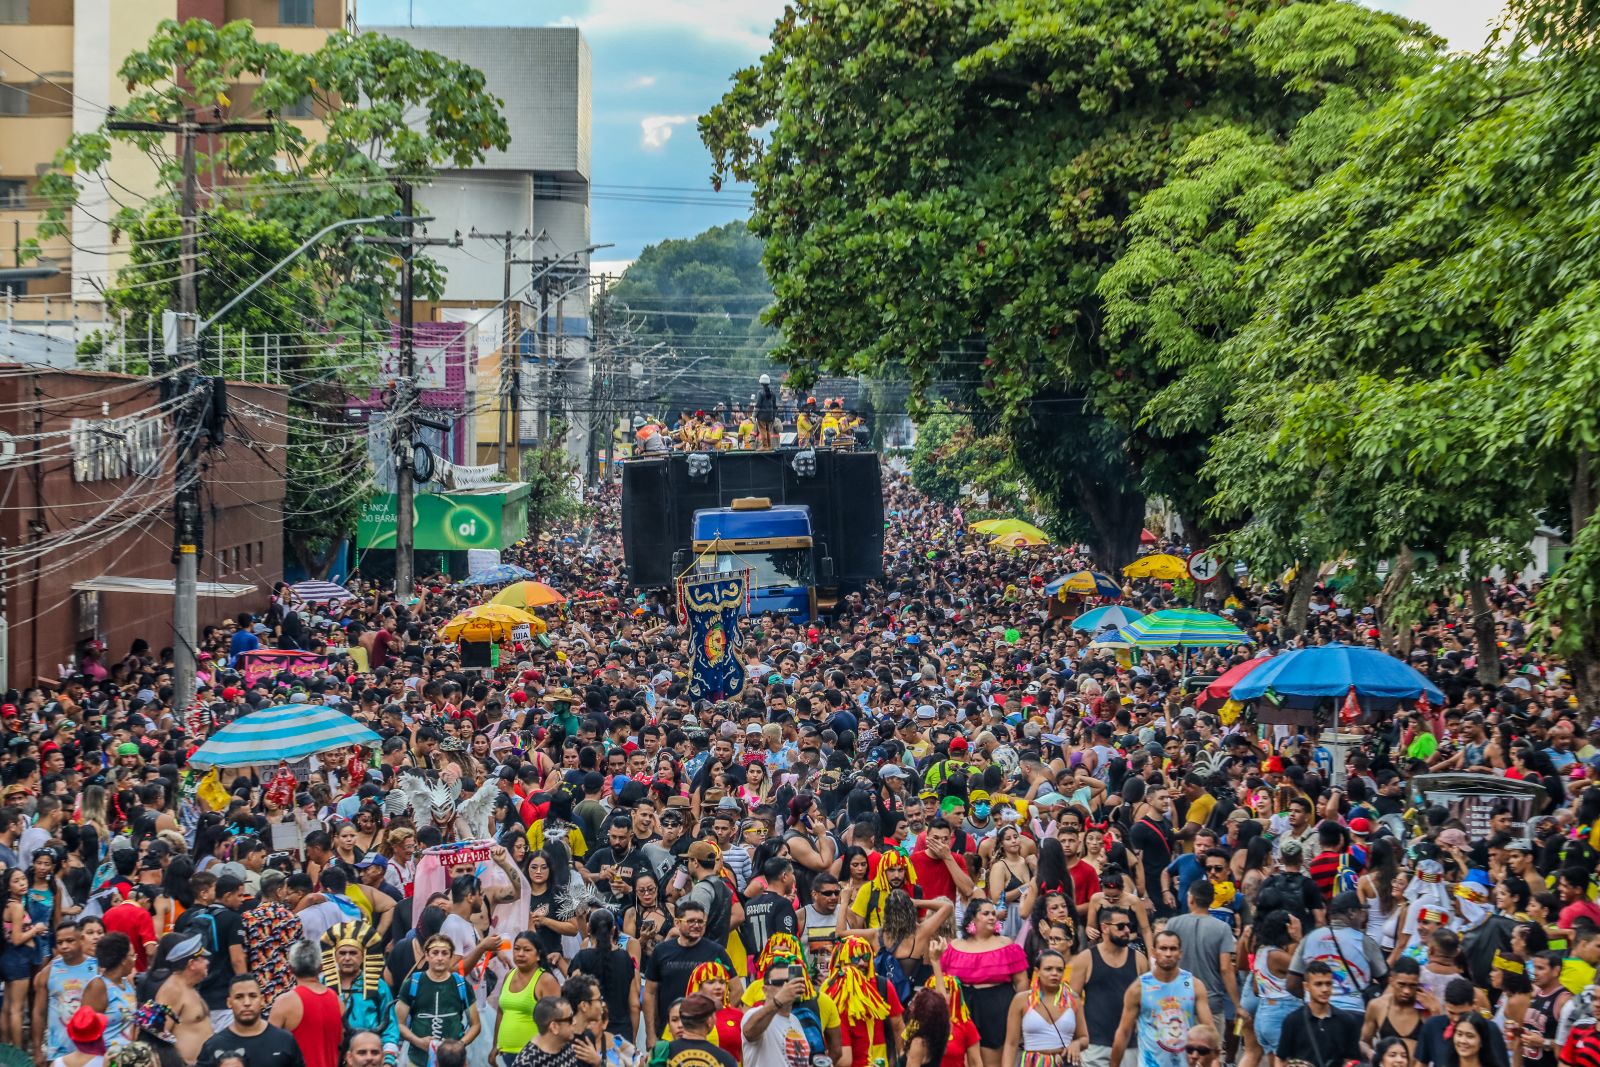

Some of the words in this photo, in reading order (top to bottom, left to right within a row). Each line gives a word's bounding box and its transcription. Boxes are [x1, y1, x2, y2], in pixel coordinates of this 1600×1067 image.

[459, 518, 476, 536] oi
[440, 847, 491, 867] PROVADOR
[750, 914, 768, 952] 11
